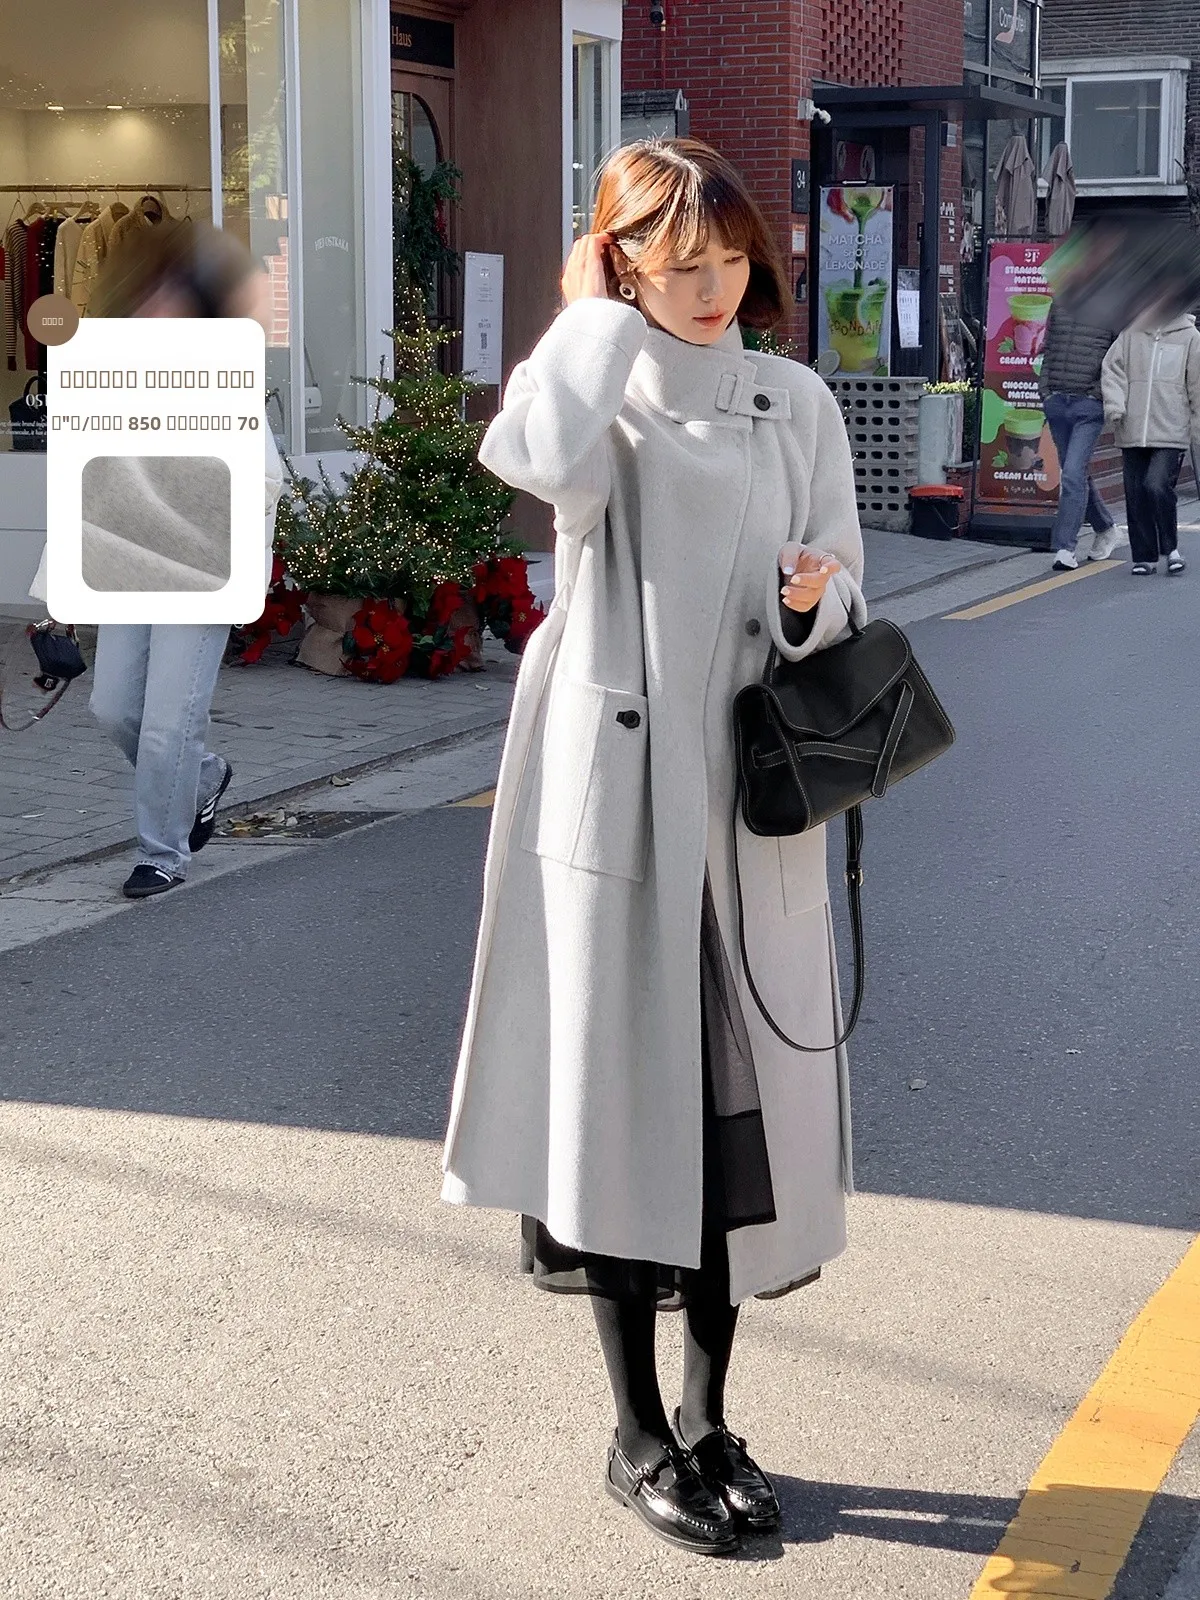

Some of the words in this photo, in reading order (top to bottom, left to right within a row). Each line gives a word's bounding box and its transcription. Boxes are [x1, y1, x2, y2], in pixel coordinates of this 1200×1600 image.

[391, 25, 412, 47] Haus
[796, 170, 806, 189] 34
[828, 234, 883, 245] MATCHA
[843, 248, 869, 257] SHOT
[825, 260, 885, 271] LEMONADE
[999, 356, 1028, 365] CREAM
[1007, 390, 1041, 400] MATCHA
[993, 471, 1022, 481] CREAM
[1023, 472, 1048, 481] LATTE
